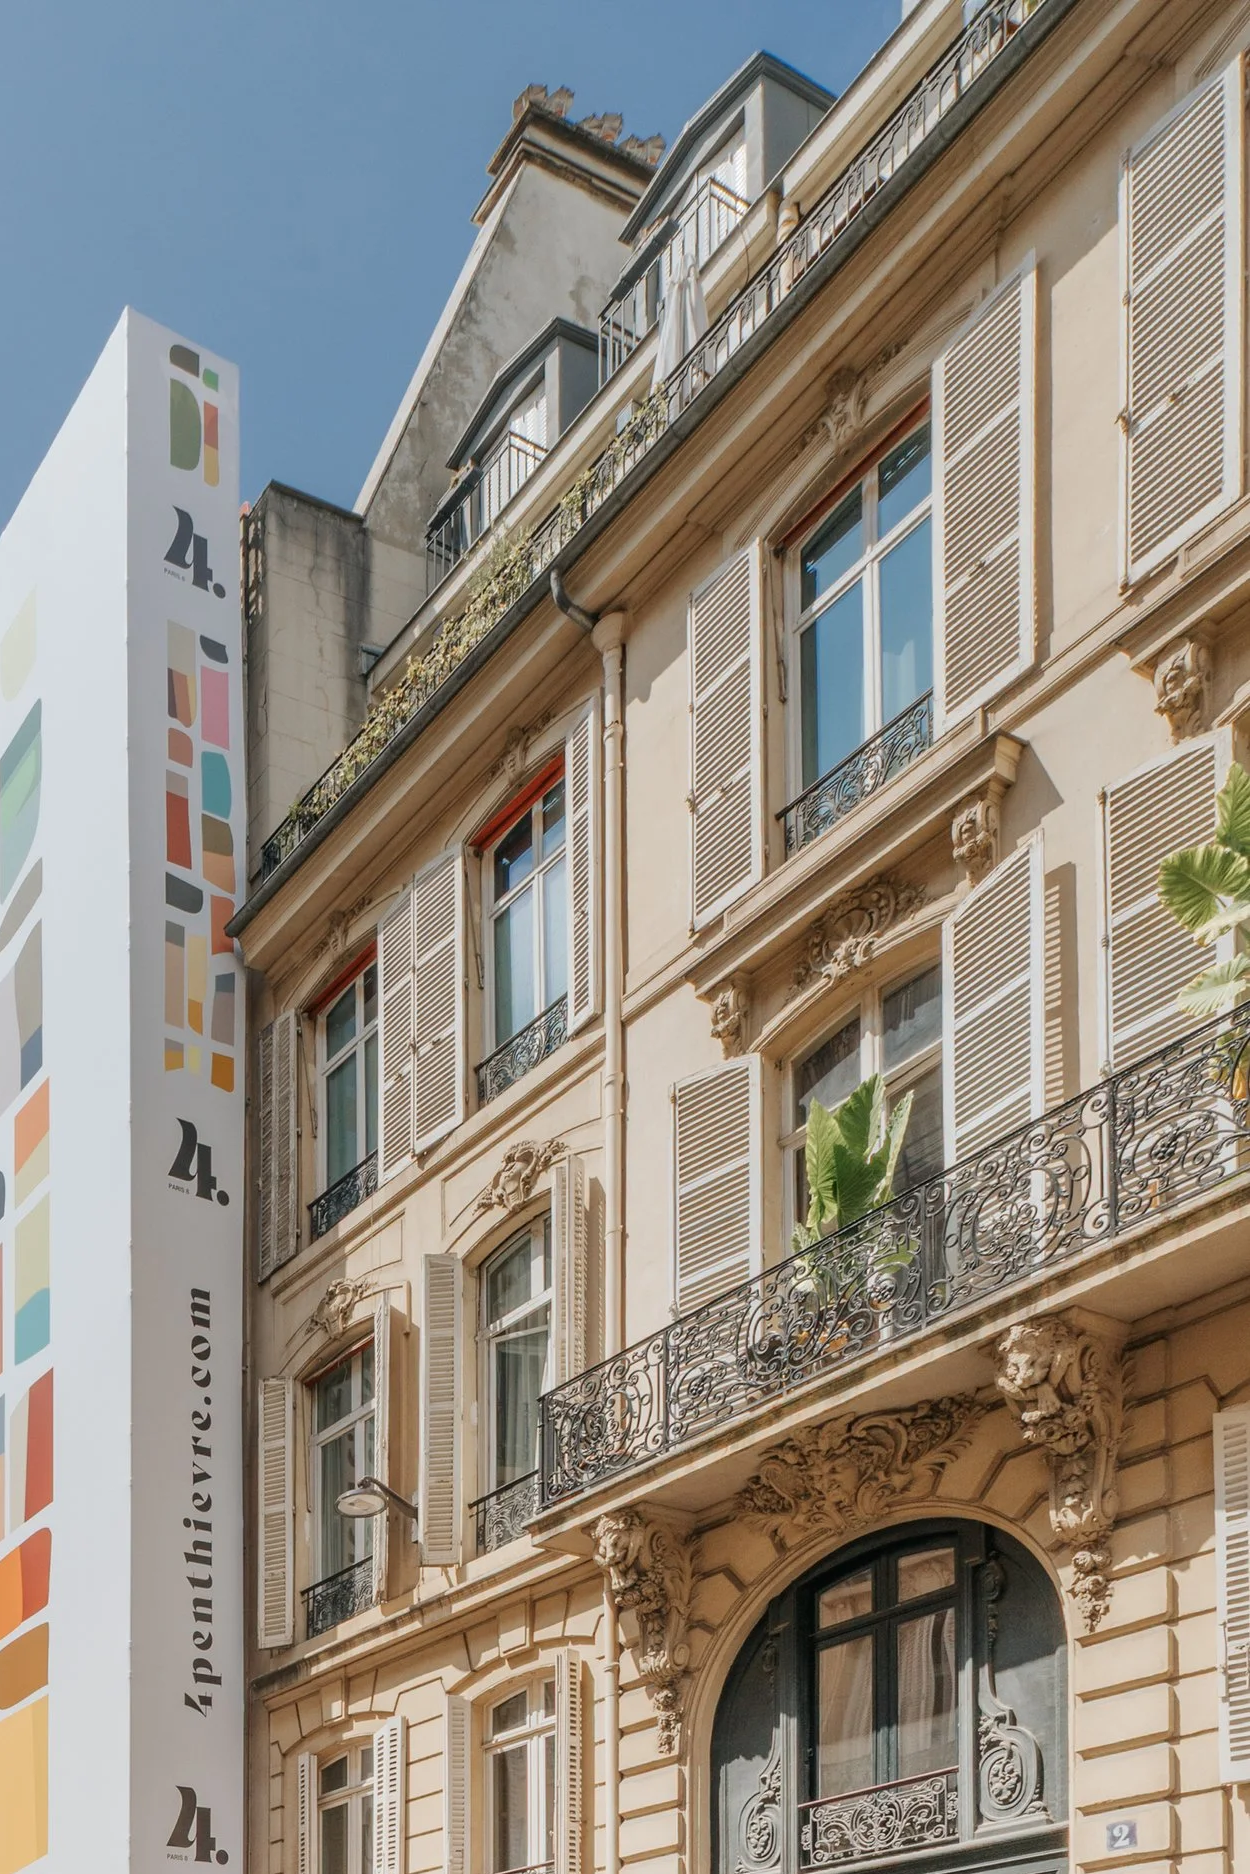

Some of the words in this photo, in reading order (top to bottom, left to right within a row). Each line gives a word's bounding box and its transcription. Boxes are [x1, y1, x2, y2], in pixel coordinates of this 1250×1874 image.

[163, 568, 181, 579] PARIS
[168, 1183, 184, 1193] PARIS
[182, 1287, 222, 1718] 4penthievre.com
[1112, 1823, 1130, 1847] 2
